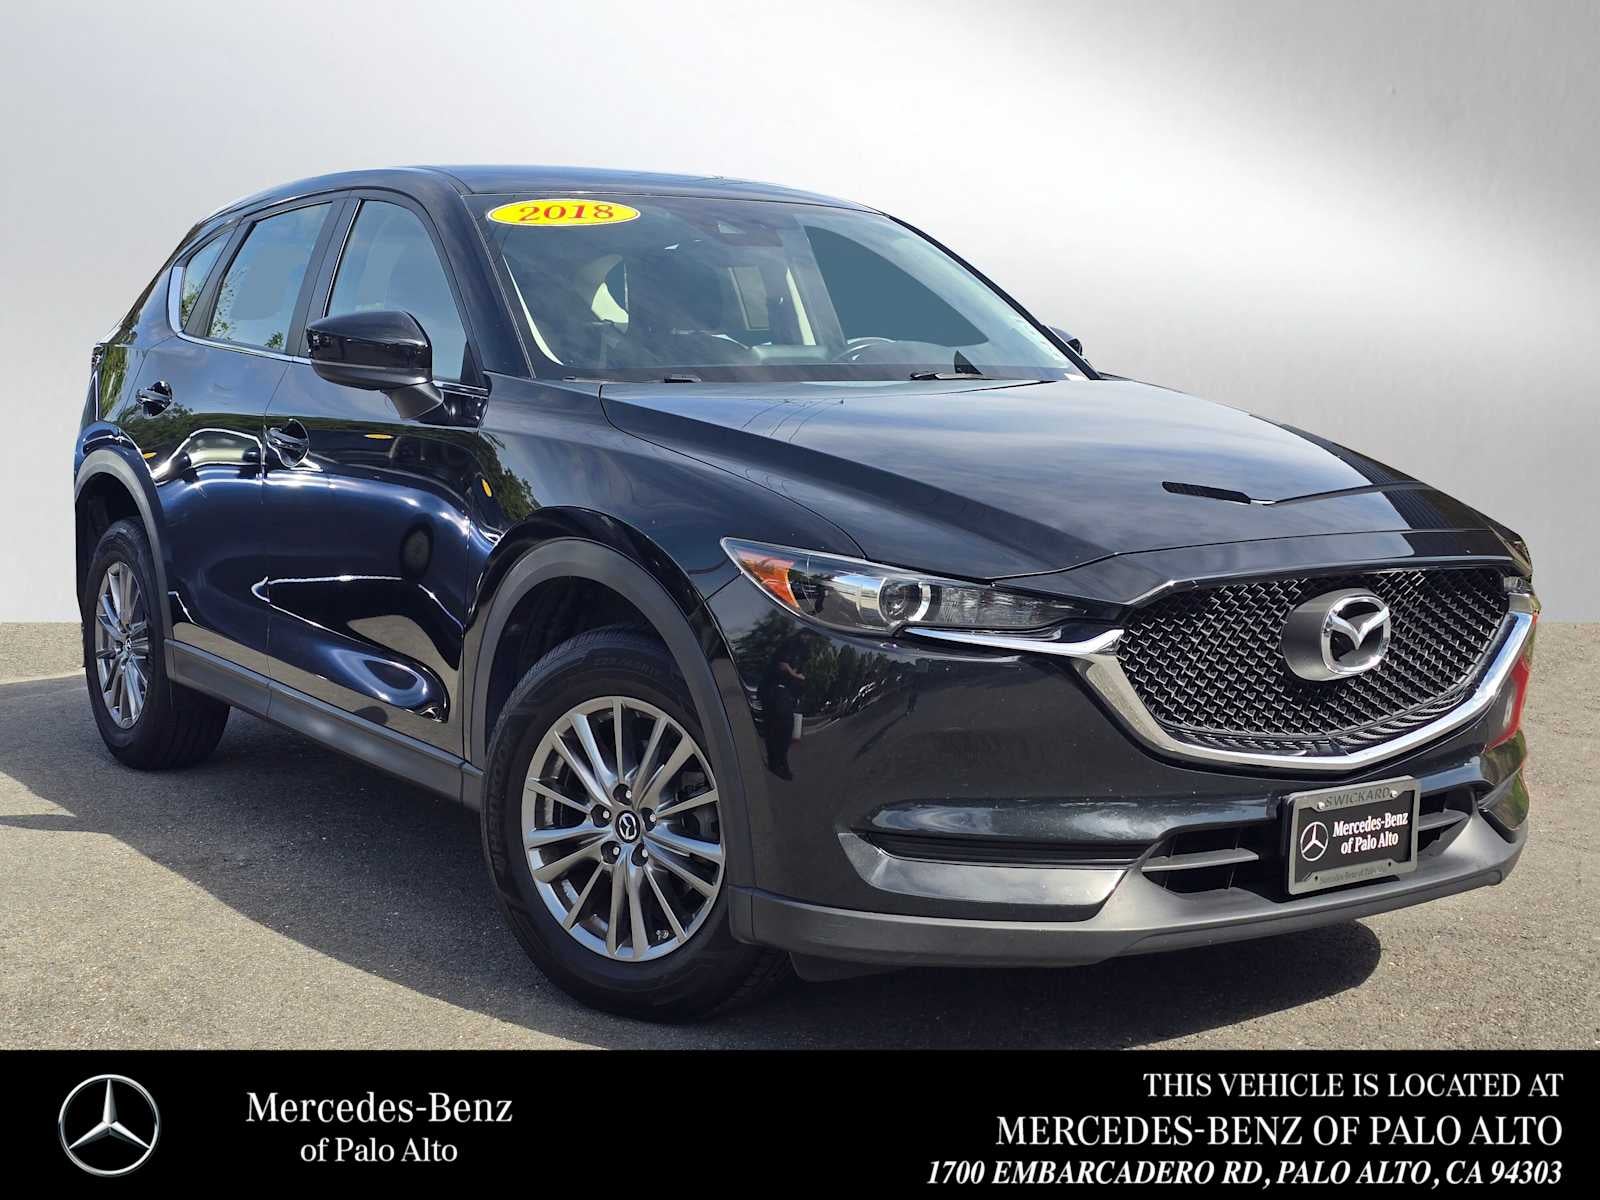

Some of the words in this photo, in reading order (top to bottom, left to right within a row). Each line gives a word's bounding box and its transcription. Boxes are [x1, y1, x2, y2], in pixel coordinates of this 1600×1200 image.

[518, 204, 614, 222] 2018
[1325, 787, 1390, 808] SWICKARD
[1332, 812, 1409, 837] Mercedes-Benz
[1340, 837, 1354, 855] of
[1355, 835, 1377, 853] Palo
[1378, 830, 1399, 848] Alto
